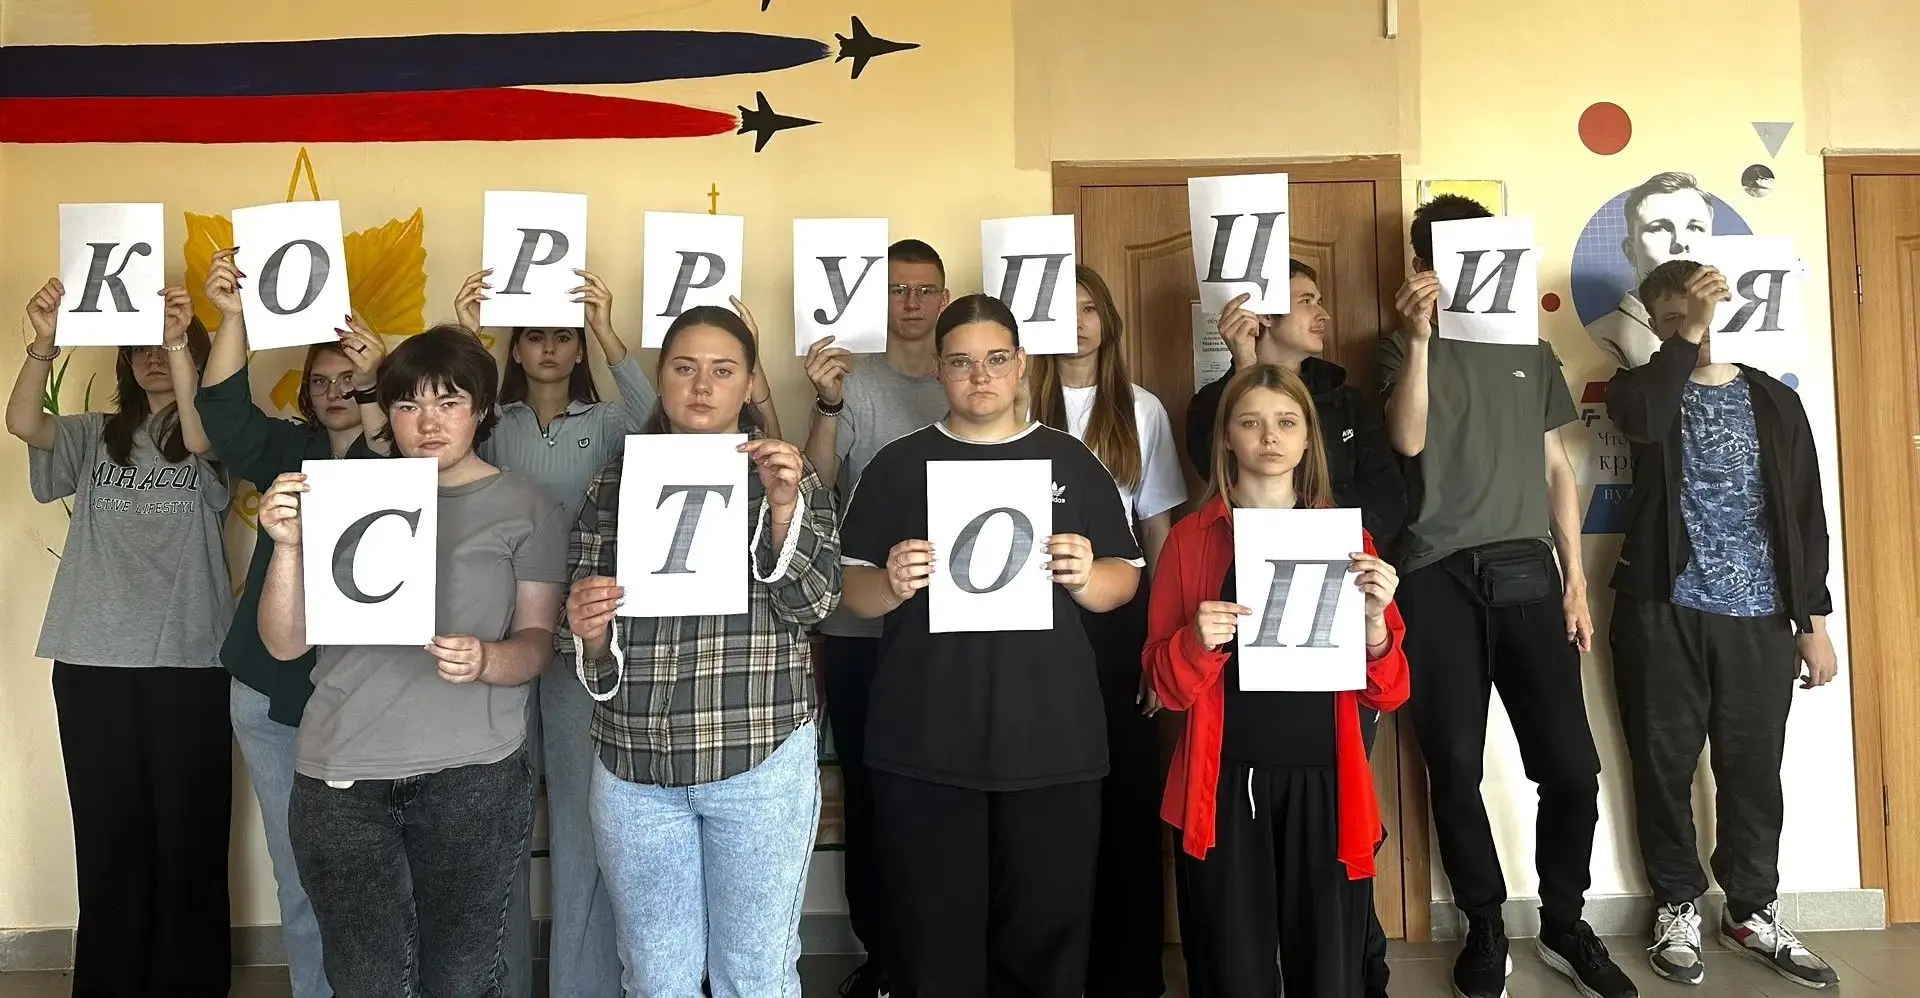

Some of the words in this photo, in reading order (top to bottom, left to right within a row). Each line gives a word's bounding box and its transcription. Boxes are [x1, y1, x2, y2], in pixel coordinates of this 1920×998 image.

[69, 242, 151, 313] К
[259, 240, 331, 315] О
[496, 228, 569, 295] Р
[656, 251, 726, 317] Р
[814, 256, 884, 325] У
[1000, 253, 1072, 322] П
[1202, 212, 1285, 301] Ц
[1443, 248, 1530, 313] И
[1717, 269, 1790, 332] Я
[332, 507, 422, 604] С
[651, 485, 734, 575] Т
[949, 507, 1033, 594] О
[1245, 559, 1353, 648] П
